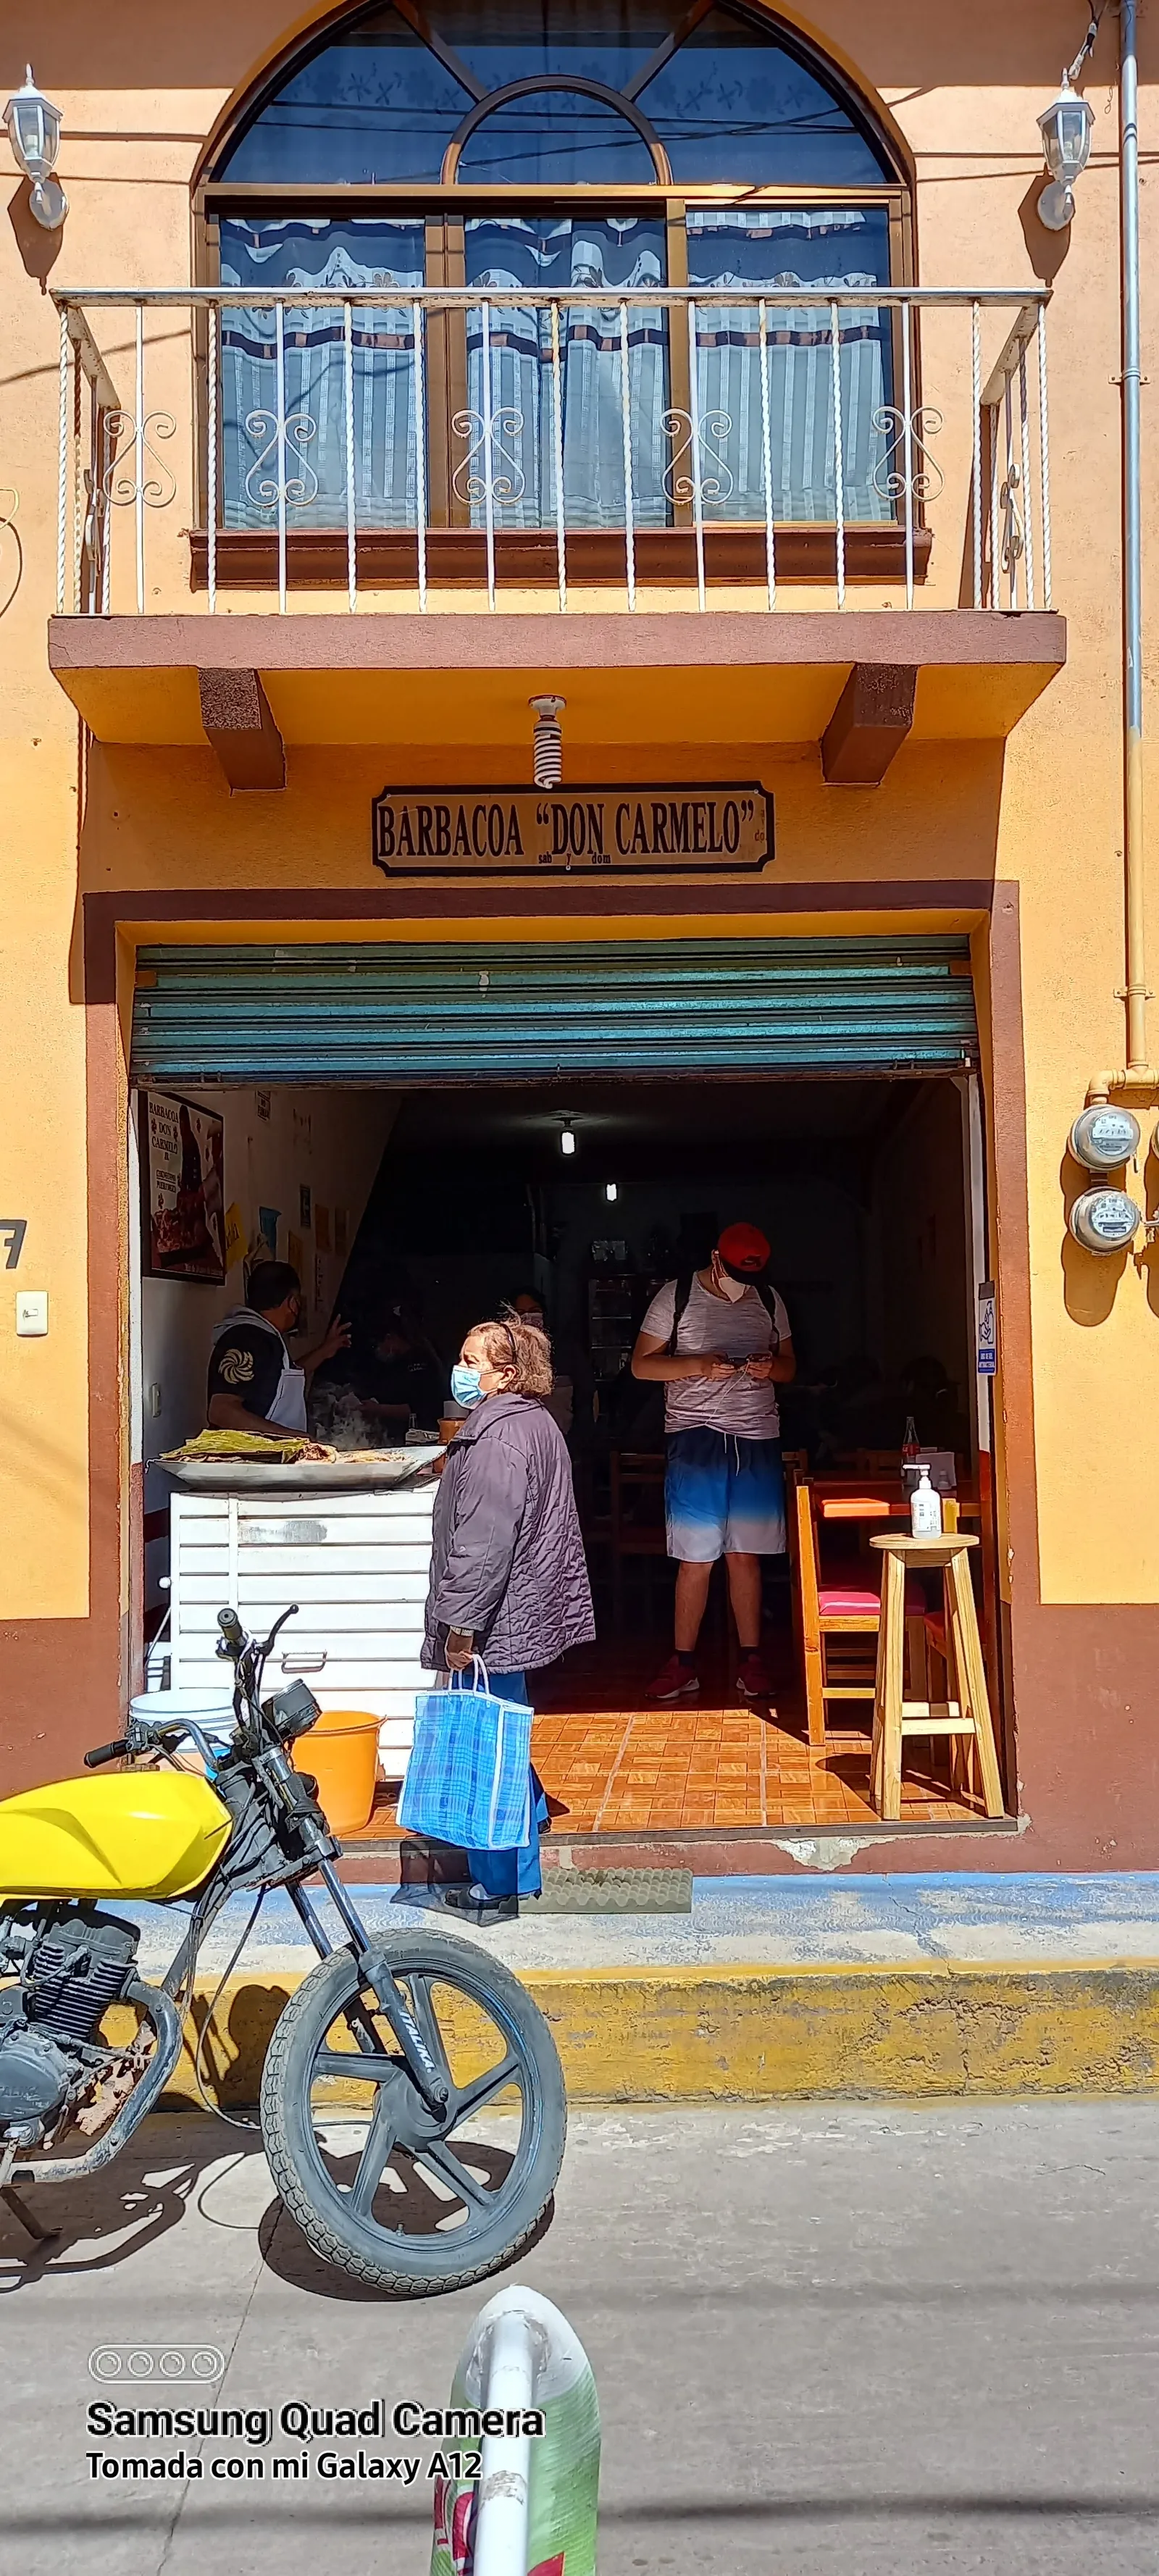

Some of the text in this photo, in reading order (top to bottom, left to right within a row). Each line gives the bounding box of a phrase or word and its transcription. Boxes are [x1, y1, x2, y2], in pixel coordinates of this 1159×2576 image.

[378, 800, 754, 857] BARBACOA “DON CARMELO”
[538, 851, 553, 864] sab
[591, 851, 612, 864] dom
[398, 2009, 436, 2070] ITALIKA
